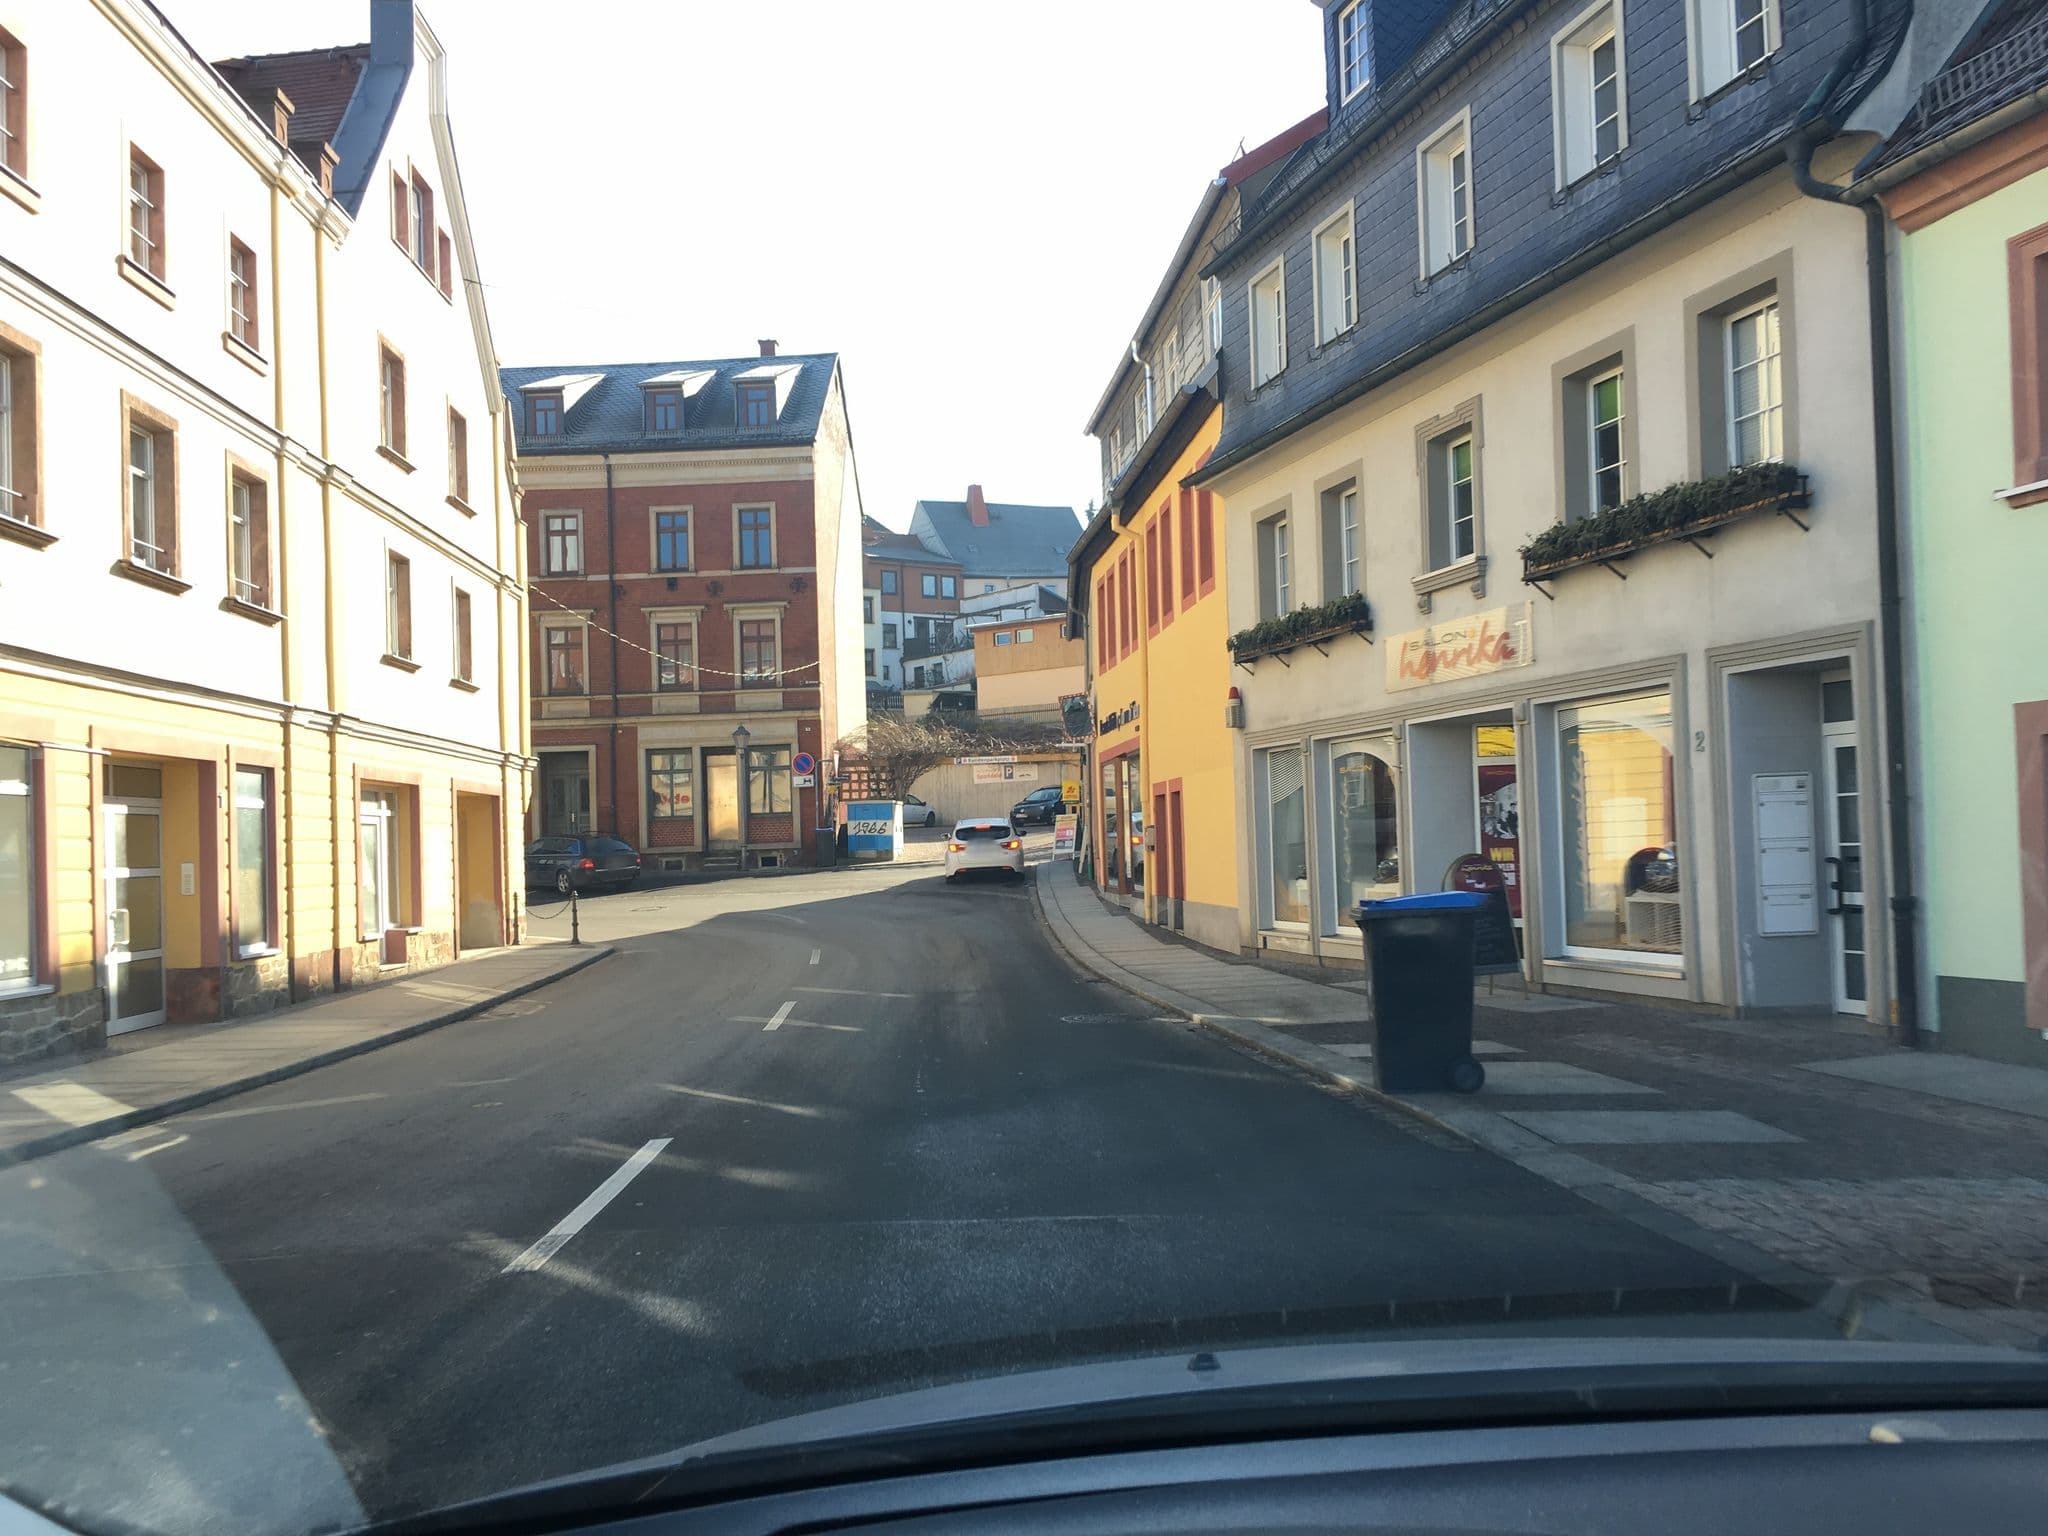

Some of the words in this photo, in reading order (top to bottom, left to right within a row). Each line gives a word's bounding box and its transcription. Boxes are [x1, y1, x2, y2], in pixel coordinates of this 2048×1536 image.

[1399, 619, 1516, 680] henrika
[1409, 630, 1467, 652] SALON
[1694, 730, 1706, 753] 2
